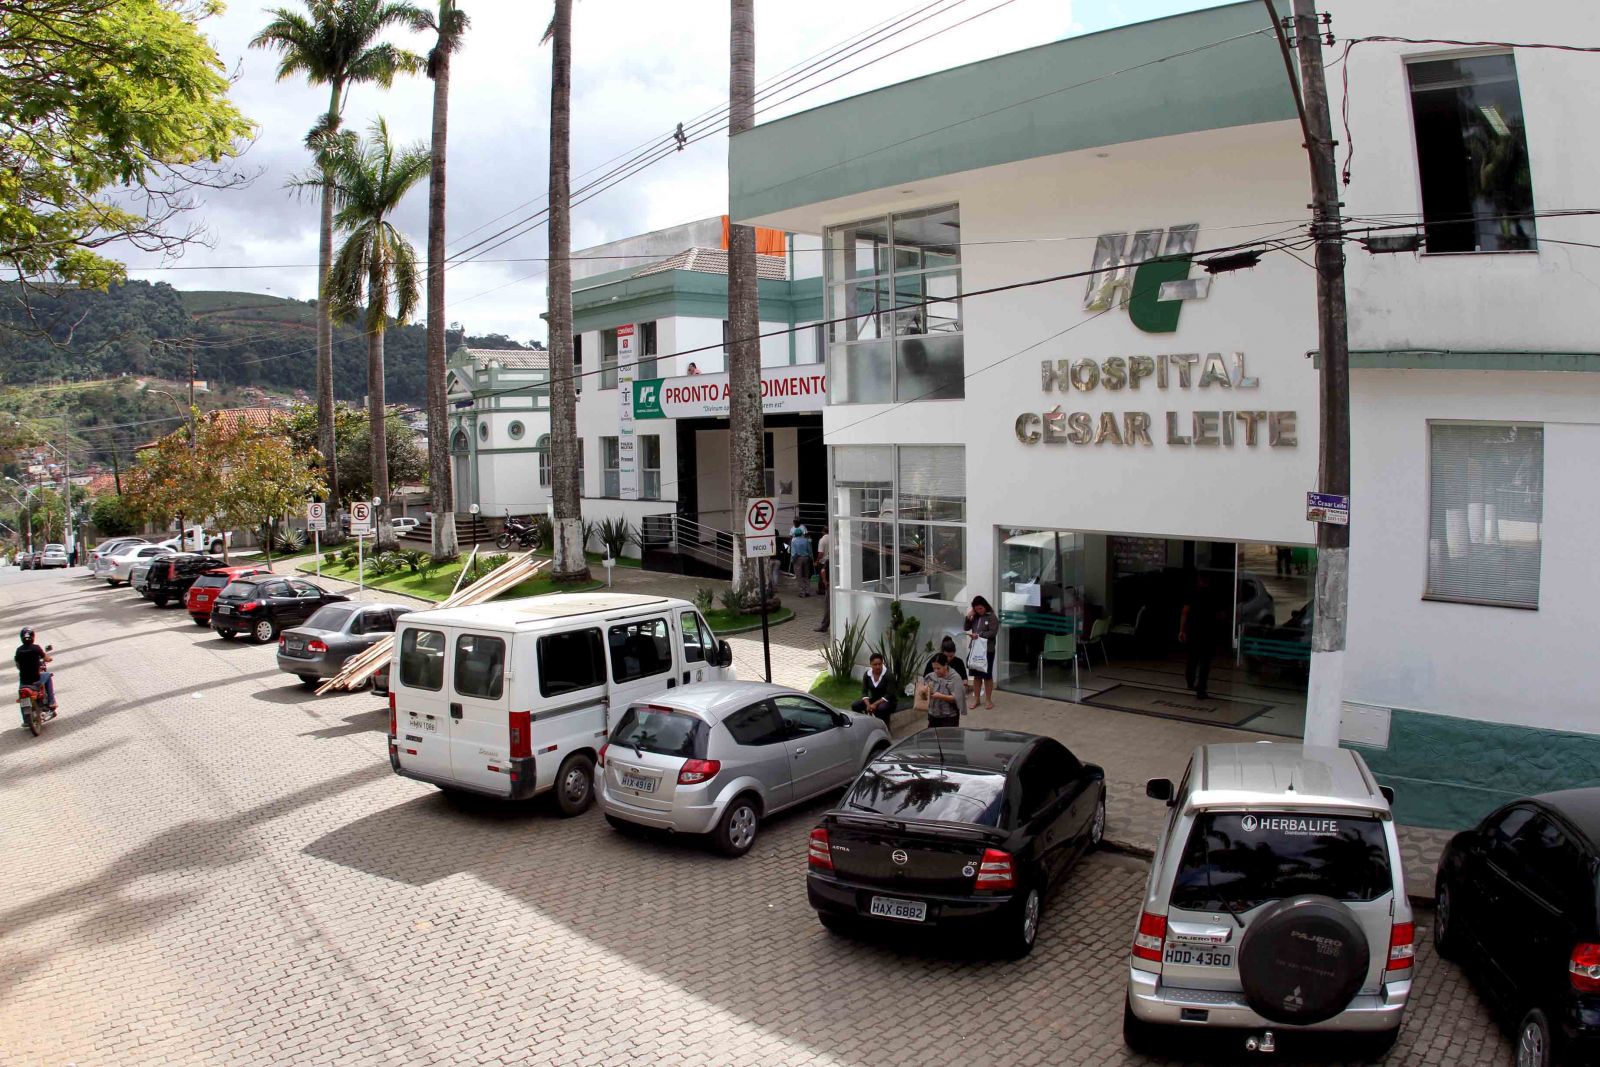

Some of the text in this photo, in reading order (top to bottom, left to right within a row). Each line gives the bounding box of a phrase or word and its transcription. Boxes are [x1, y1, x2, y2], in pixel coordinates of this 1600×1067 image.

[1041, 352, 1259, 392] HOSPITAL
[666, 384, 719, 404] PRONTO
[1015, 404, 1298, 447] CÉSAR LEITE
[1260, 818, 1337, 832] HERBALIFE
[1290, 930, 1343, 947] PAJERO
